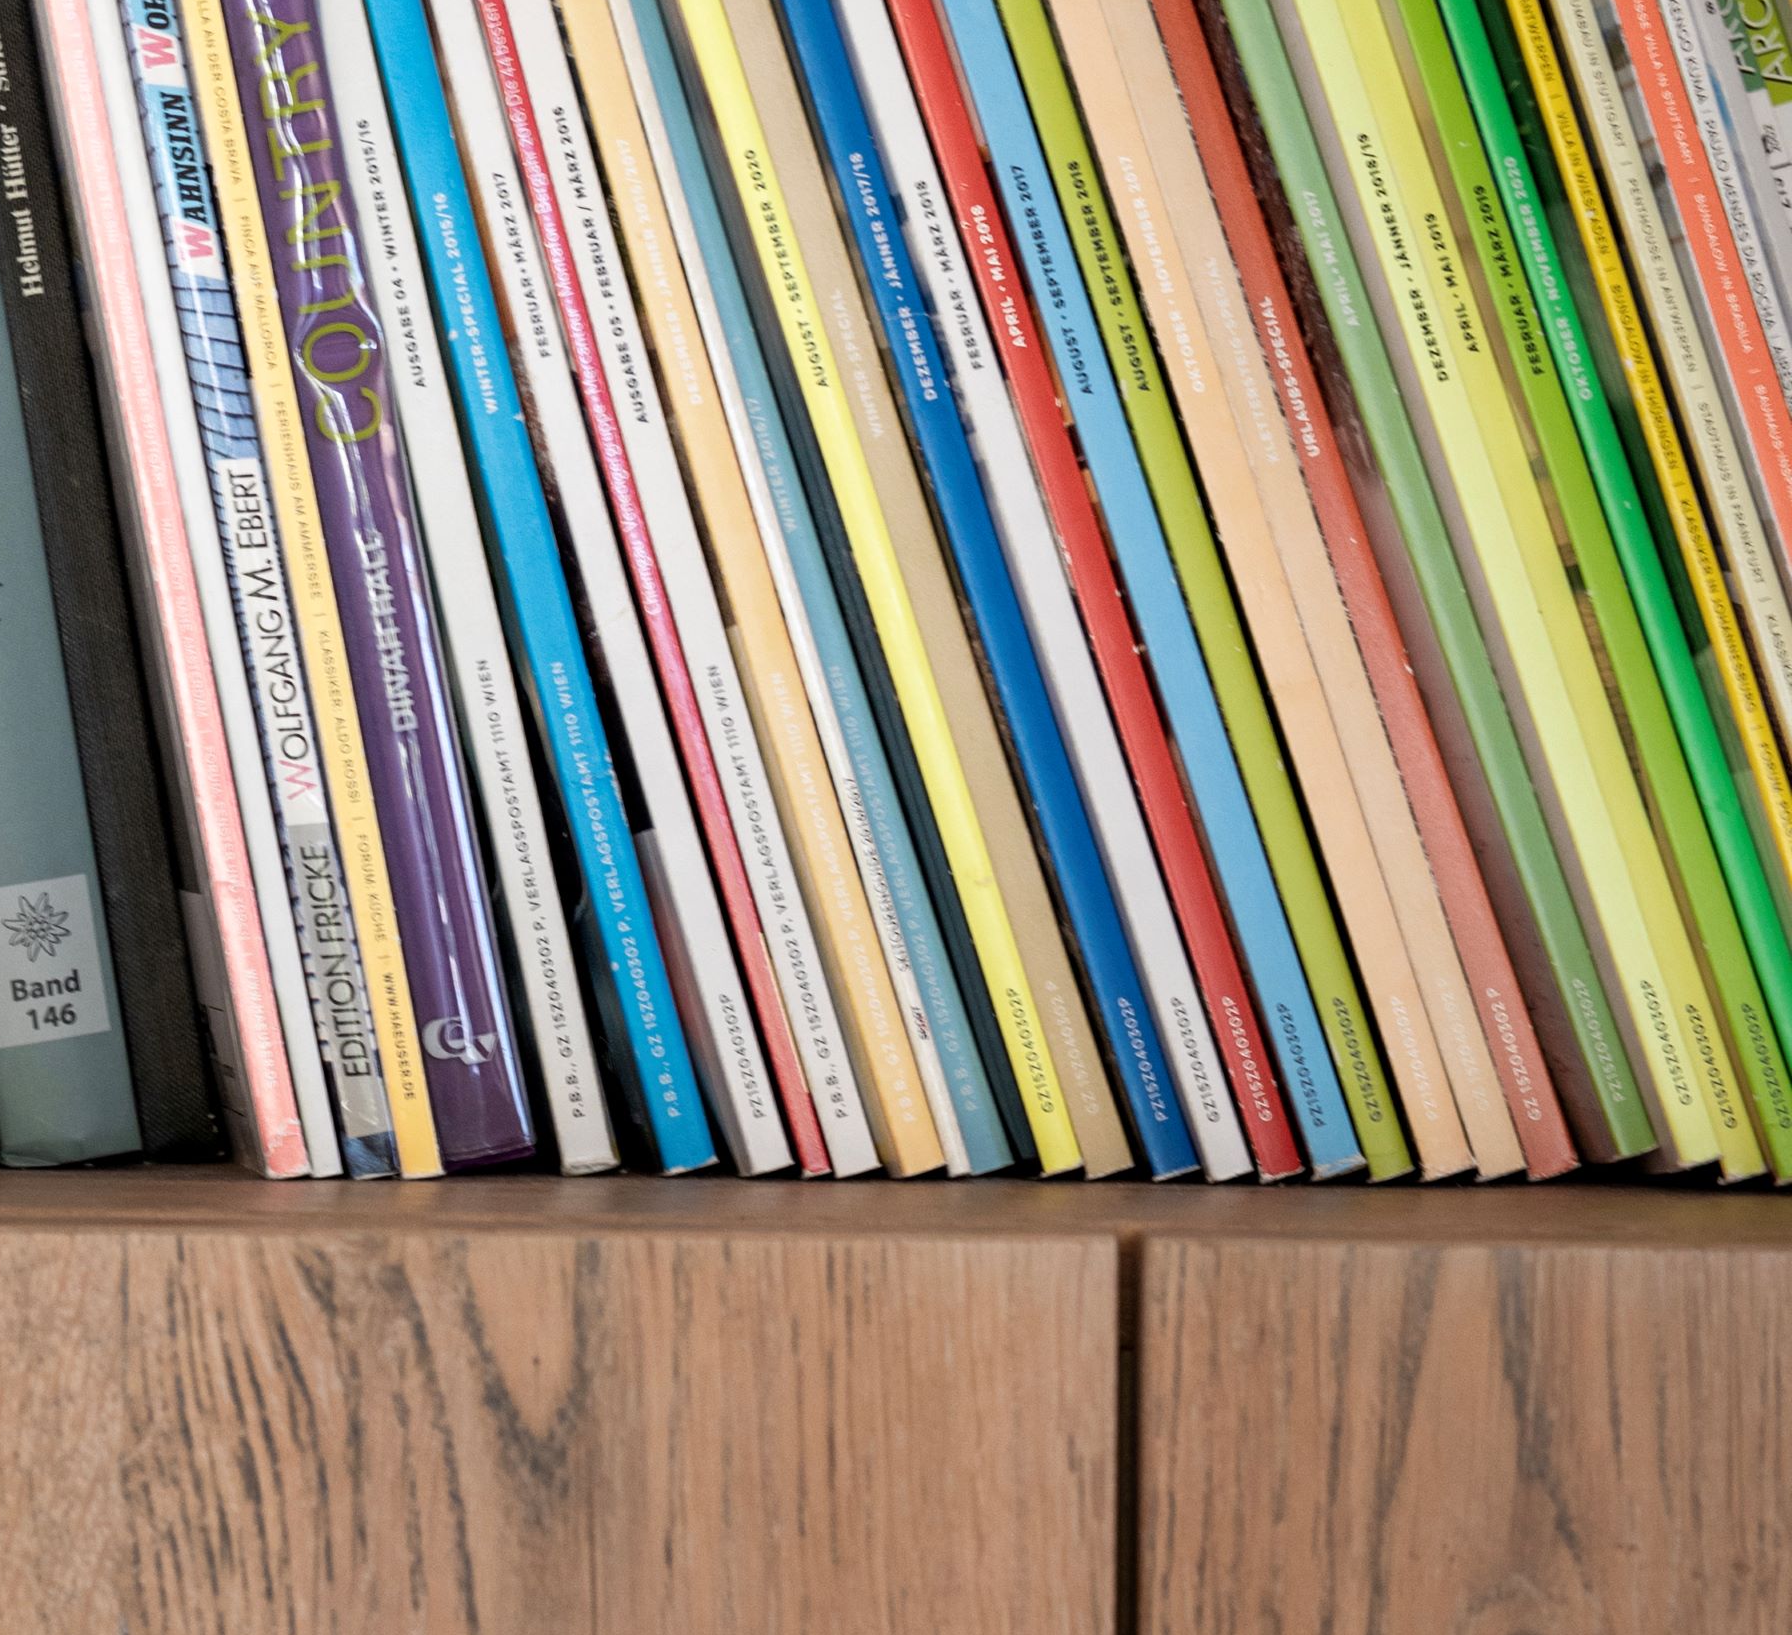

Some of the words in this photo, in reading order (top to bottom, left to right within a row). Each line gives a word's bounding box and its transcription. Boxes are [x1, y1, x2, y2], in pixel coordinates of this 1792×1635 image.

[158, 90, 218, 259] WAHNSINN
[355, 117, 384, 183] 2015/16
[848, 151, 881, 215] 2017/18
[11, 208, 46, 296] Helmut
[245, 6, 384, 442] COUNTRY
[373, 189, 399, 259] WINTER
[433, 191, 461, 257] 2015/16
[581, 216, 614, 297] FEBRUAR
[760, 200, 803, 301] SEPTEMBER
[1022, 205, 1066, 308] SEPTEMBER
[1079, 203, 1123, 305] SEPTEMBER
[1519, 203, 1560, 299] NOVEMBER
[398, 304, 428, 388] AUSGABE
[451, 262, 499, 413] WINTER-SPECIAL
[521, 276, 552, 357] FEBRUAR
[796, 319, 831, 387] AUGUST
[898, 306, 938, 400] DEZEMBER
[948, 290, 985, 369] FEBRUAR
[1118, 322, 1149, 391] AUGUST
[1407, 288, 1449, 381] DEZEMBER
[1506, 293, 1544, 374] FEBRUAR
[617, 340, 650, 423] AUSGABE
[1061, 326, 1093, 394] AUGUST
[1260, 295, 1321, 456] URLAUBS-SPECIAL
[1554, 317, 1594, 400] OKTOBER
[226, 467, 268, 548] EBERT
[242, 557, 278, 602] M.
[260, 608, 318, 800] WOLFGANG
[301, 843, 346, 943] FRICKE
[11, 967, 82, 1002] Band
[26, 1002, 77, 1030] 146
[319, 951, 372, 1077] EDITION
